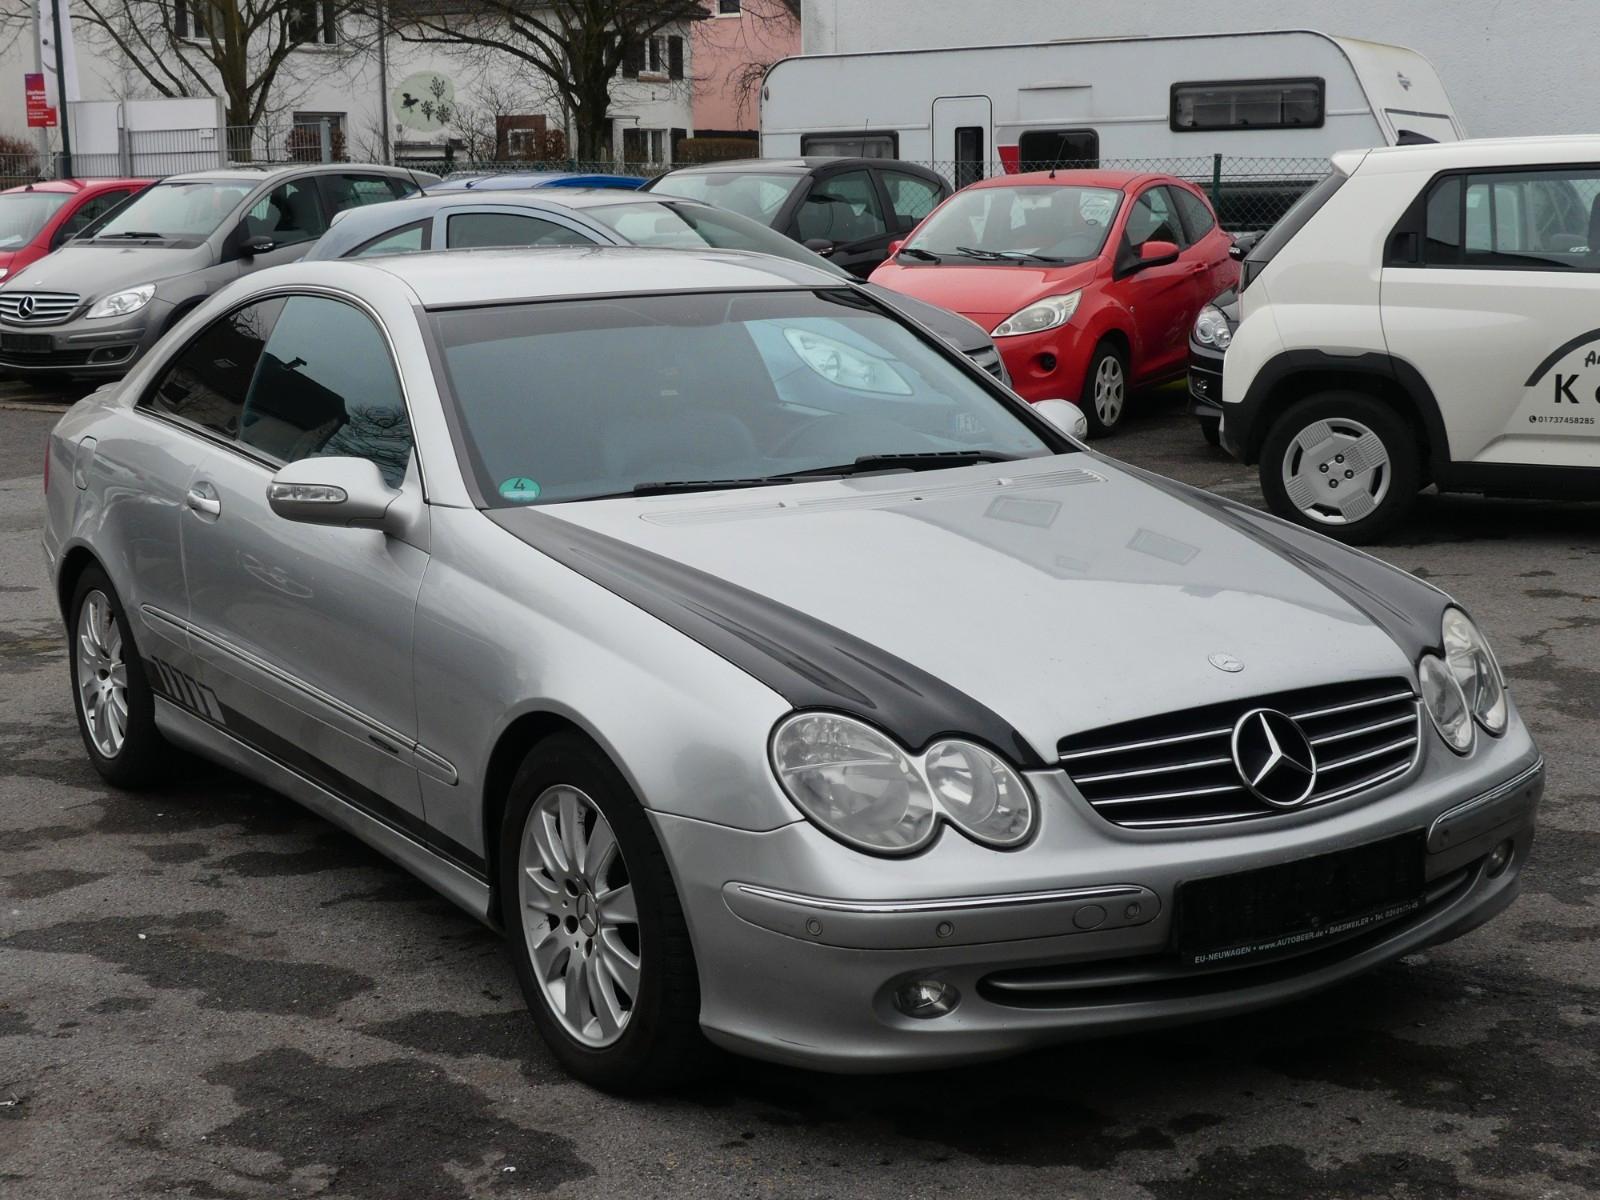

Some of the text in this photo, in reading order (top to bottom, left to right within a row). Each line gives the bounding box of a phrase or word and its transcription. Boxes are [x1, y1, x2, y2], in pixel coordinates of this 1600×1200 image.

[1538, 416, 1595, 424] 01737458285
[513, 479, 526, 491] 4
[1194, 946, 1251, 964] EU-NEUWAGEN
